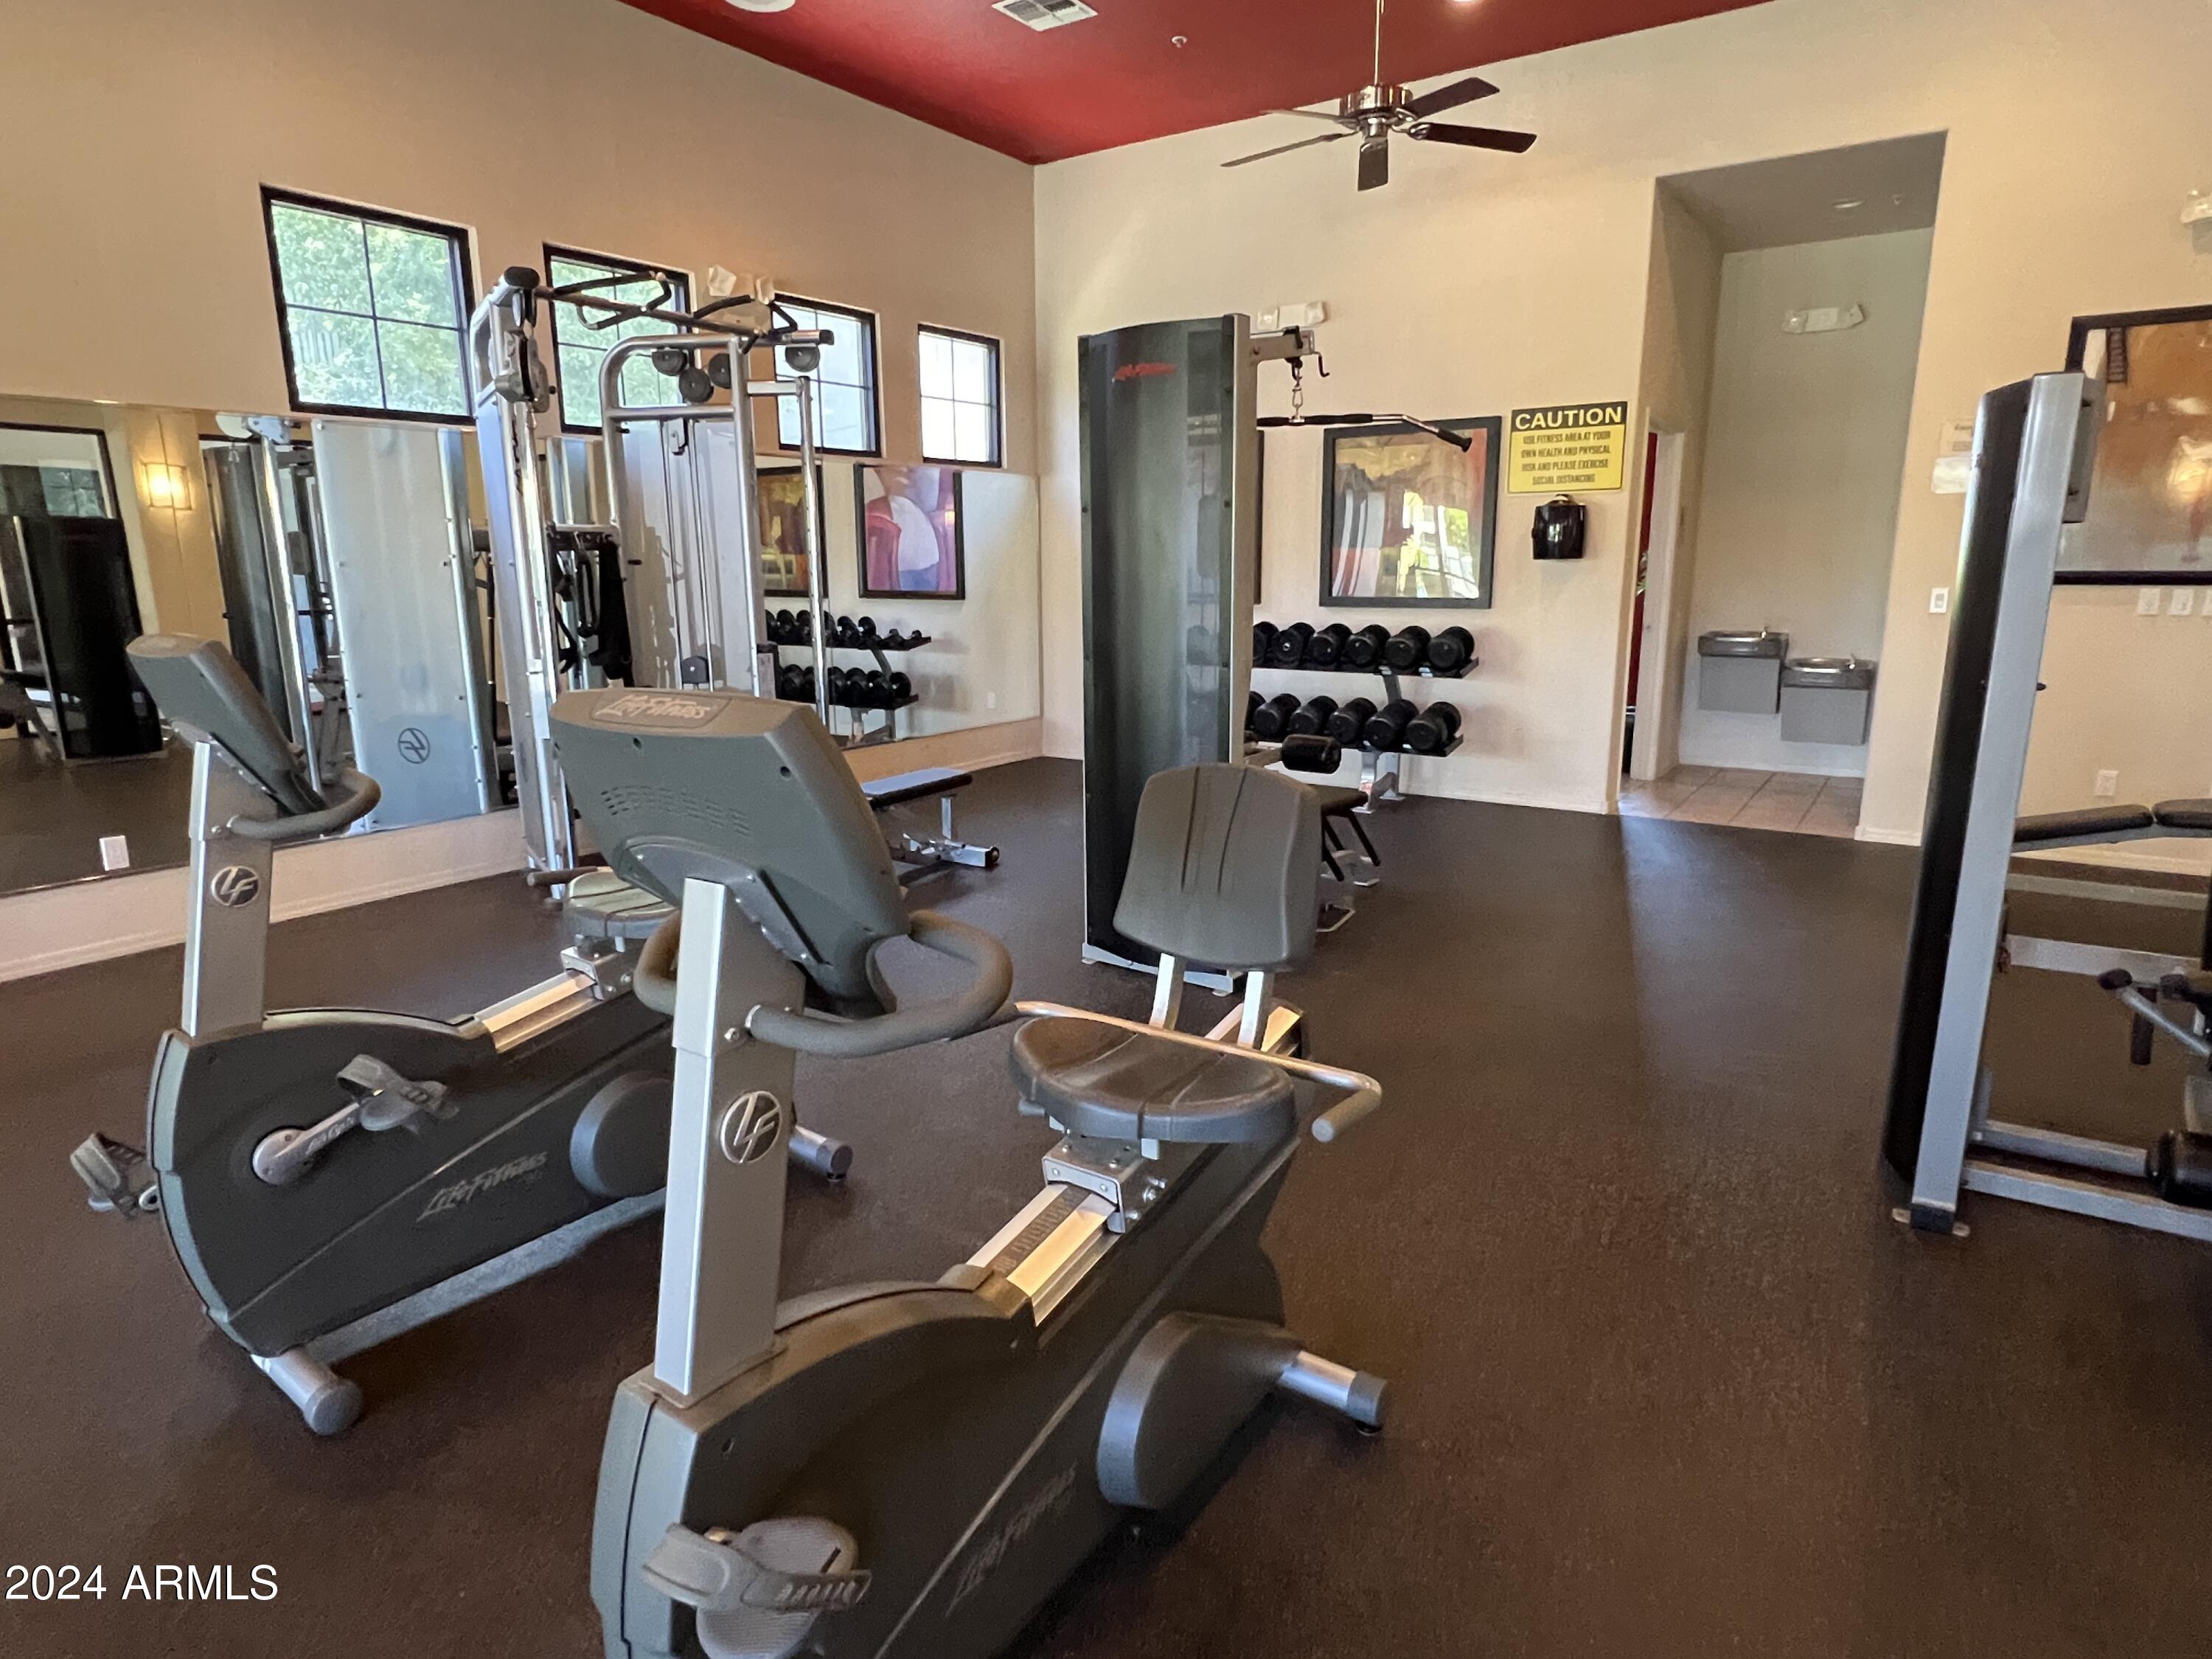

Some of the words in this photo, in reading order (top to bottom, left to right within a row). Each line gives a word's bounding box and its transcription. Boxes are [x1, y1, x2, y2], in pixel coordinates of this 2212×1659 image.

[1515, 406, 1621, 430] CAUTION
[1523, 436, 1535, 445] USE
[1537, 434, 1563, 443] FITNESS
[1565, 432, 1582, 442] AREA
[1583, 431, 1591, 441] AT
[1593, 431, 1610, 440] YOUR
[1521, 449, 1537, 459] OWN
[1538, 448, 1562, 457] HEALTH
[1564, 447, 1577, 456] AND
[1579, 445, 1610, 455] PHYSICAL
[1522, 463, 1536, 472] RISK
[1537, 462, 1551, 471] AND
[1552, 460, 1576, 470] PLEASE
[1578, 459, 1609, 470] EXERCISE
[1532, 476, 1554, 485] SOCIAL
[1556, 473, 1596, 484] DISTANCING
